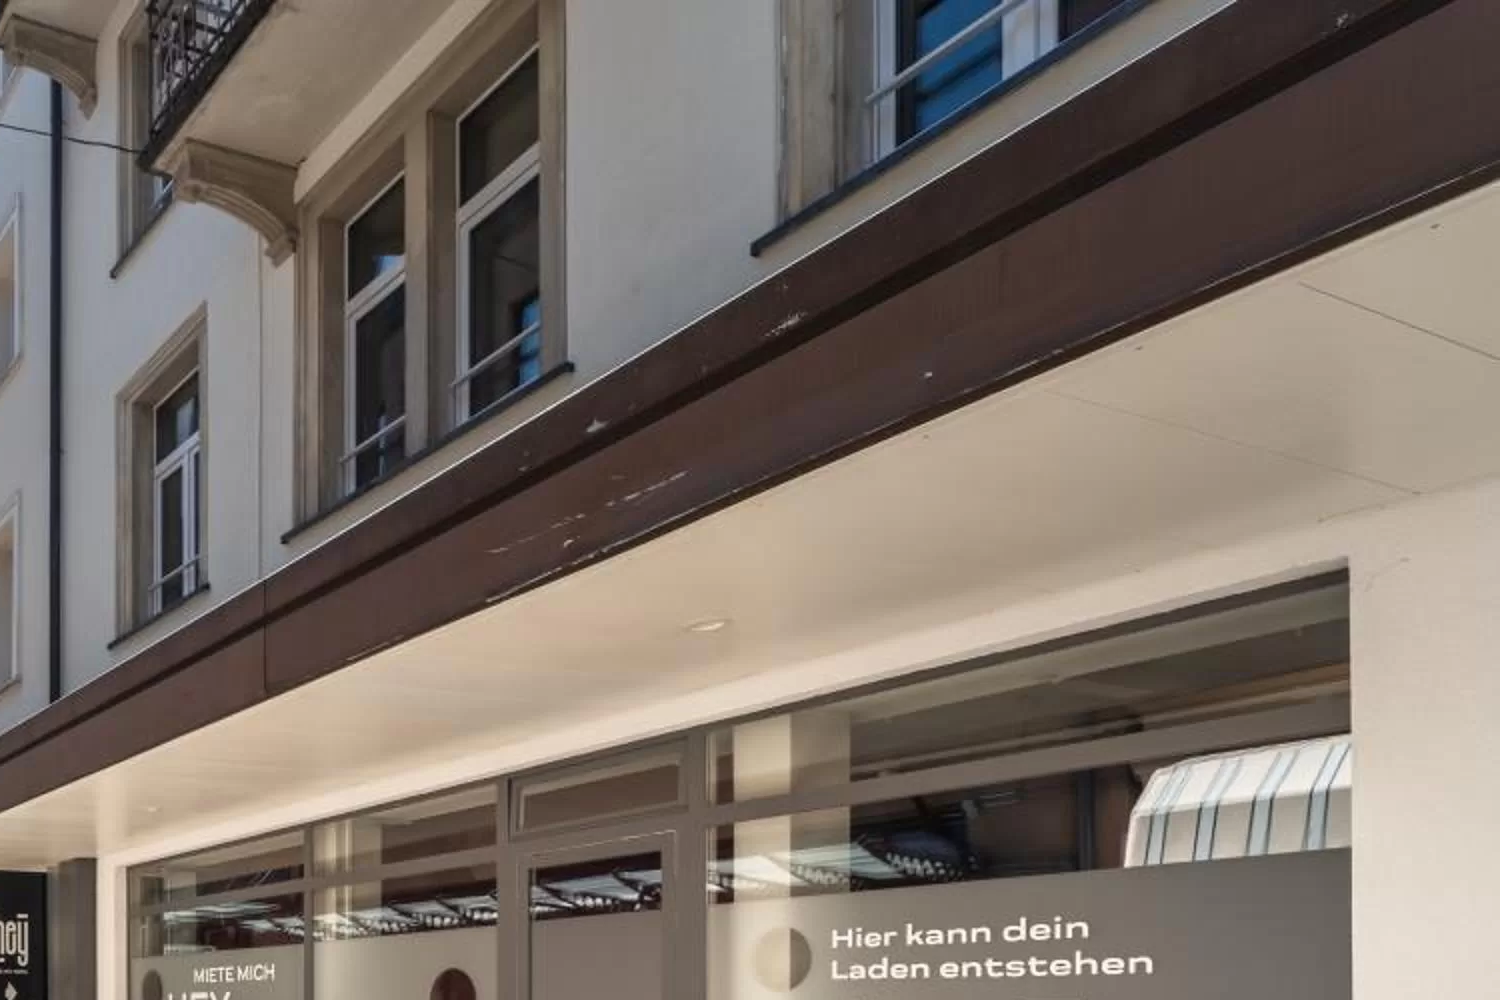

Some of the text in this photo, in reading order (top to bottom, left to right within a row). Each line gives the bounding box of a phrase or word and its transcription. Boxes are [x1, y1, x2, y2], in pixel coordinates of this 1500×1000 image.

[831, 916, 1089, 948] Hier kann dein
[193, 963, 275, 983] MIETE MICH
[831, 950, 1153, 979] Laden entstehen
